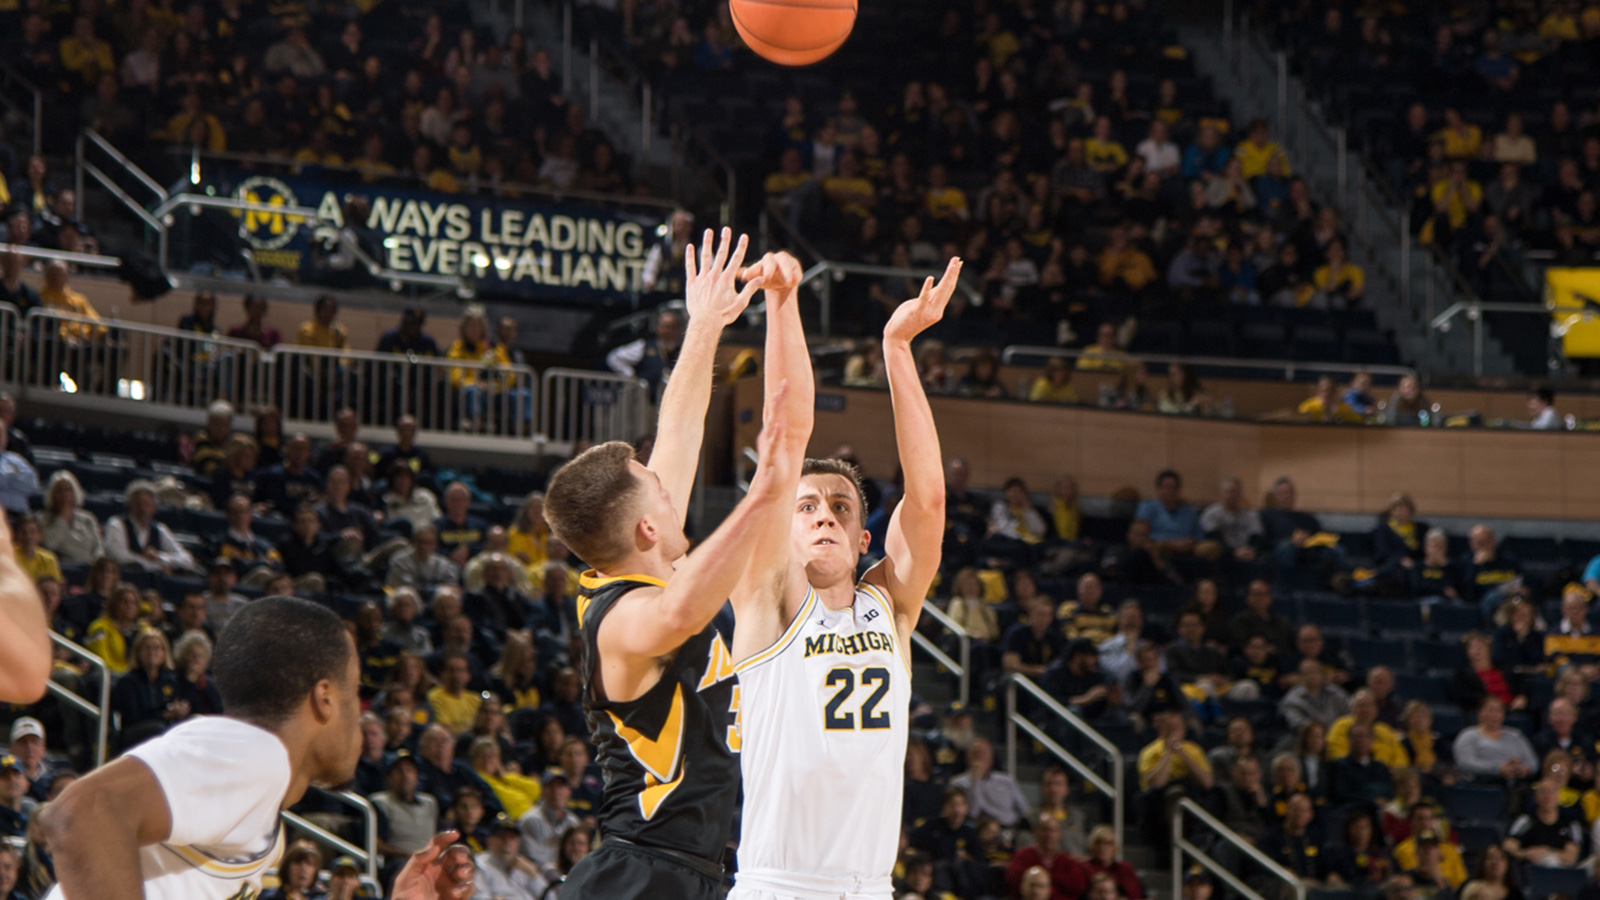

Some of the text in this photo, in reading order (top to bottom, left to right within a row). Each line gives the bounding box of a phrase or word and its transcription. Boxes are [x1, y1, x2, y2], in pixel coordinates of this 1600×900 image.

[317, 191, 471, 240] AWAYS
[490, 246, 646, 292] VALIANT
[804, 630, 894, 659] MICHIGA
[824, 667, 891, 731] 22
